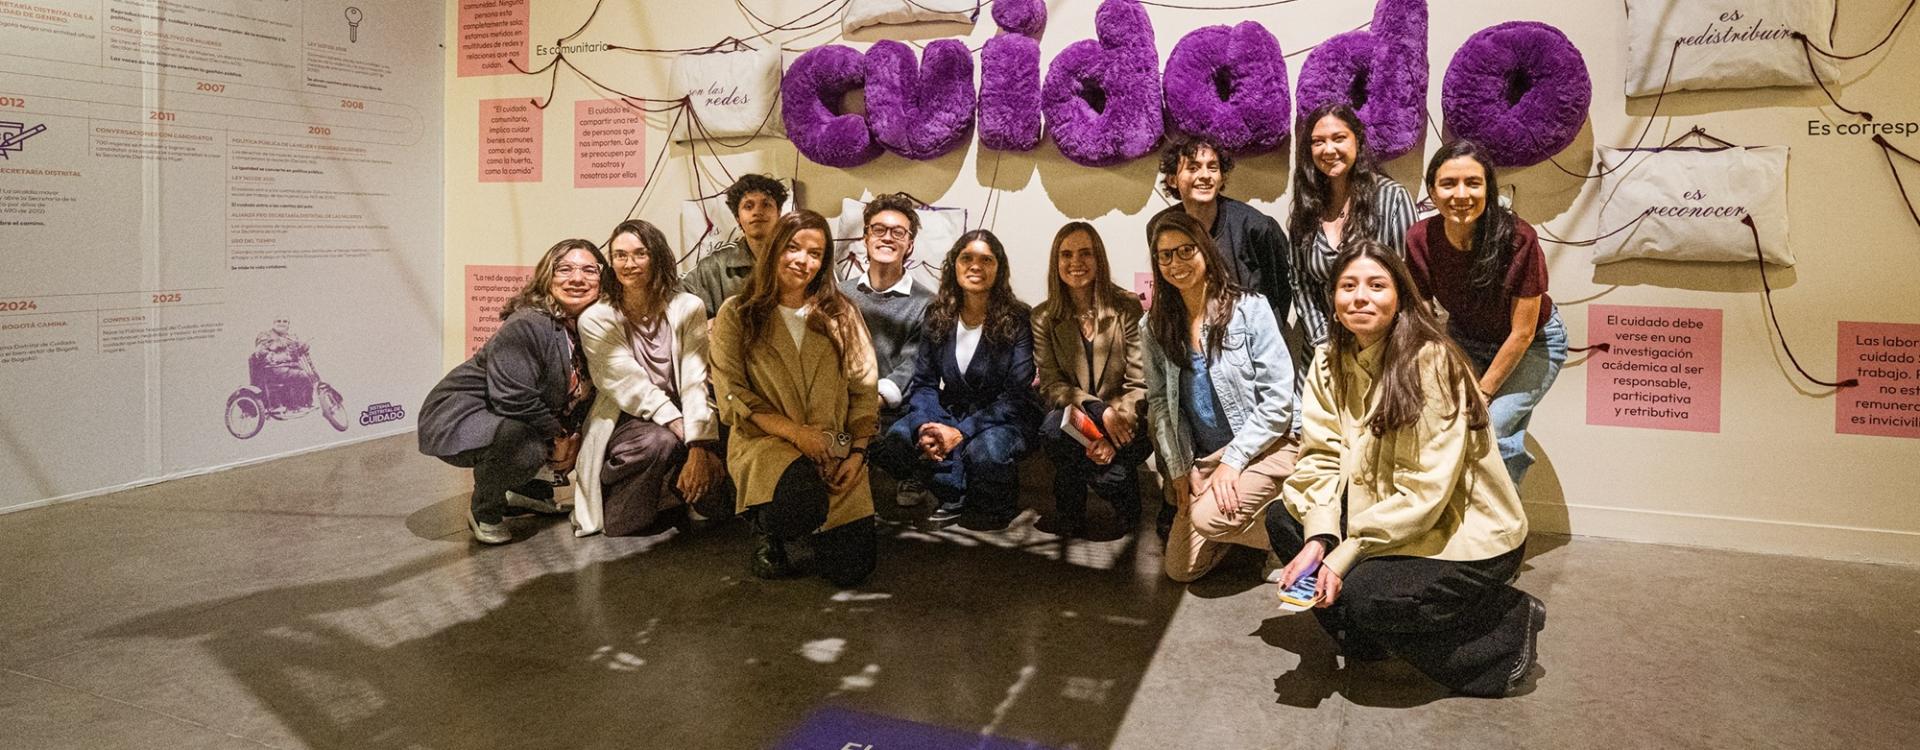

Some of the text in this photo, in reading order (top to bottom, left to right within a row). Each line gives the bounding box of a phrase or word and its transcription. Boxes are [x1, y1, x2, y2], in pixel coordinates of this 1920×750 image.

[34, 7, 72, 17] DISTRITAL
[474, 11, 499, 19] persona
[1719, 9, 1744, 22] es
[463, 20, 508, 30] completamente
[1677, 18, 1793, 46] redistribuir
[463, 42, 493, 50] multitudes
[536, 41, 609, 56] Es comunitario
[197, 81, 225, 93] 2007
[708, 81, 725, 95] las
[780, 0, 1592, 168] cuidado
[705, 86, 751, 106] redes
[341, 99, 364, 110] 2008
[150, 111, 175, 121] 2011
[588, 107, 594, 115] El
[595, 106, 621, 115] cuidado
[579, 118, 612, 127] compartir
[1808, 120, 1831, 136] Es
[308, 126, 331, 136] 2010
[489, 127, 510, 135] implica
[623, 128, 635, 136] que
[591, 140, 622, 148] importen.
[624, 137, 639, 146] Que
[589, 151, 624, 159] preocupen
[621, 161, 626, 169] y
[45, 169, 81, 177] DISTRITAL
[1683, 189, 1706, 201] es
[1647, 205, 1748, 217] reconocer
[152, 293, 182, 304] 2025
[487, 296, 504, 304] grupo
[0, 300, 37, 312] 2024
[2, 320, 67, 331] BOGOTÁ CAMINA
[1607, 315, 1704, 329] El cuidado debe
[1615, 333, 1692, 344] verse en una
[1856, 335, 1880, 346] Las
[1613, 345, 1693, 360] investigación
[1859, 352, 1915, 364] cuidado
[1601, 361, 1705, 375] acádemica al ser
[1857, 367, 1912, 381] trabajo.
[1613, 377, 1692, 390] responsable,
[1880, 386, 1897, 394] no
[1613, 391, 1692, 404] participativa
[360, 410, 405, 425] CUIDADO
[1614, 406, 1689, 419] y retributiva
[1851, 416, 1866, 424] es
